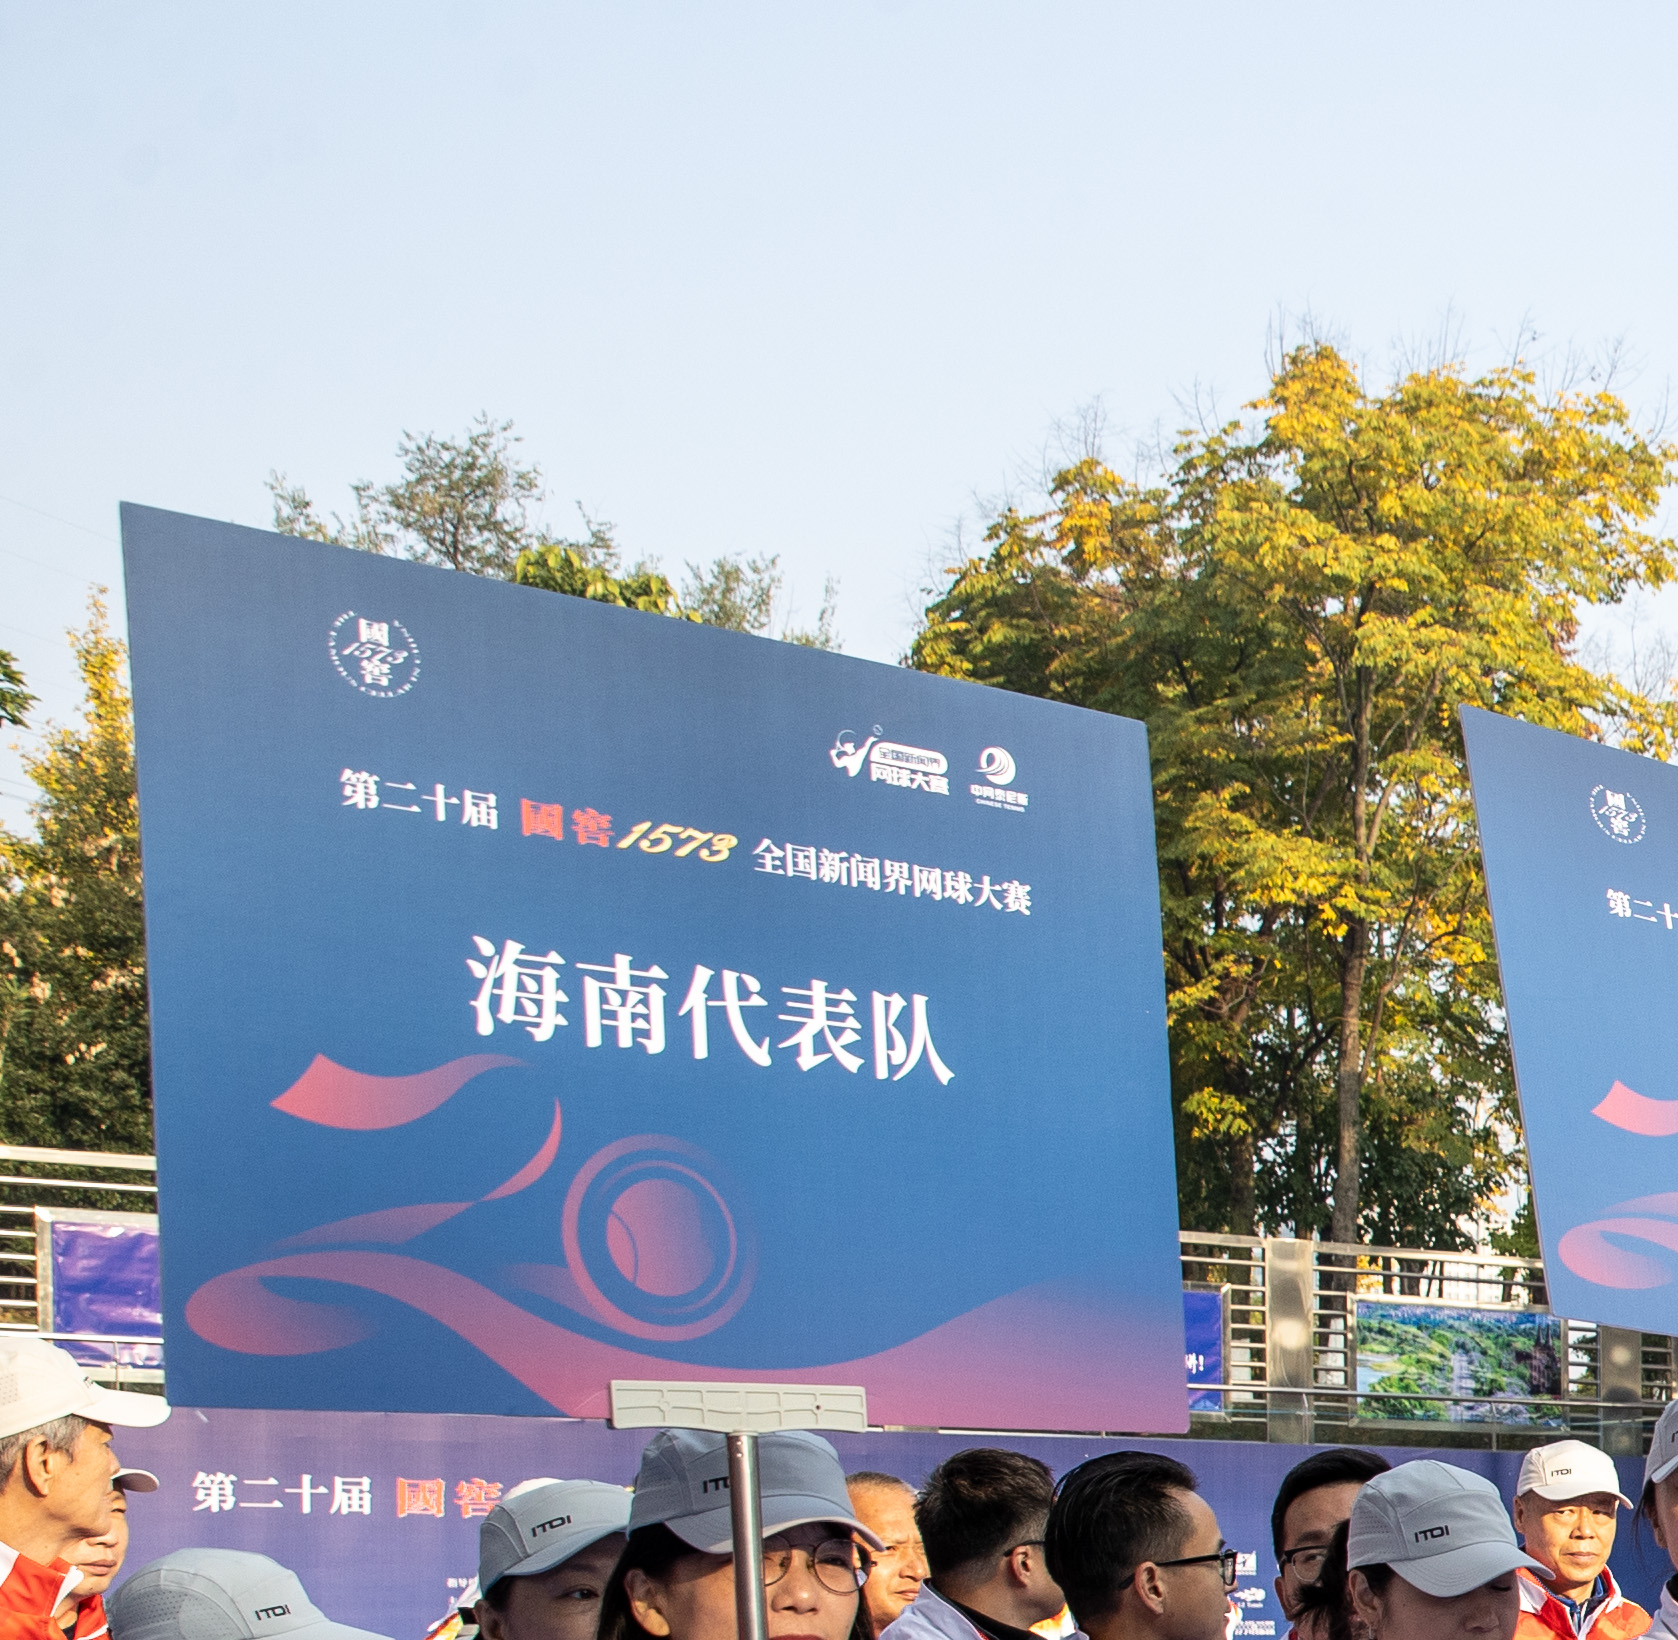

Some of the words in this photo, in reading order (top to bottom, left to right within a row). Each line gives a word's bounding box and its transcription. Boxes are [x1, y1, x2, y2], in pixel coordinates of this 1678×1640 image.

[870, 762, 950, 796] 网球大赛
[339, 768, 498, 829] 第二十届
[752, 838, 1032, 915] 全国新闻界网球大赛
[465, 935, 955, 1085] 海南代表队
[192, 1471, 372, 1516] 第二十届
